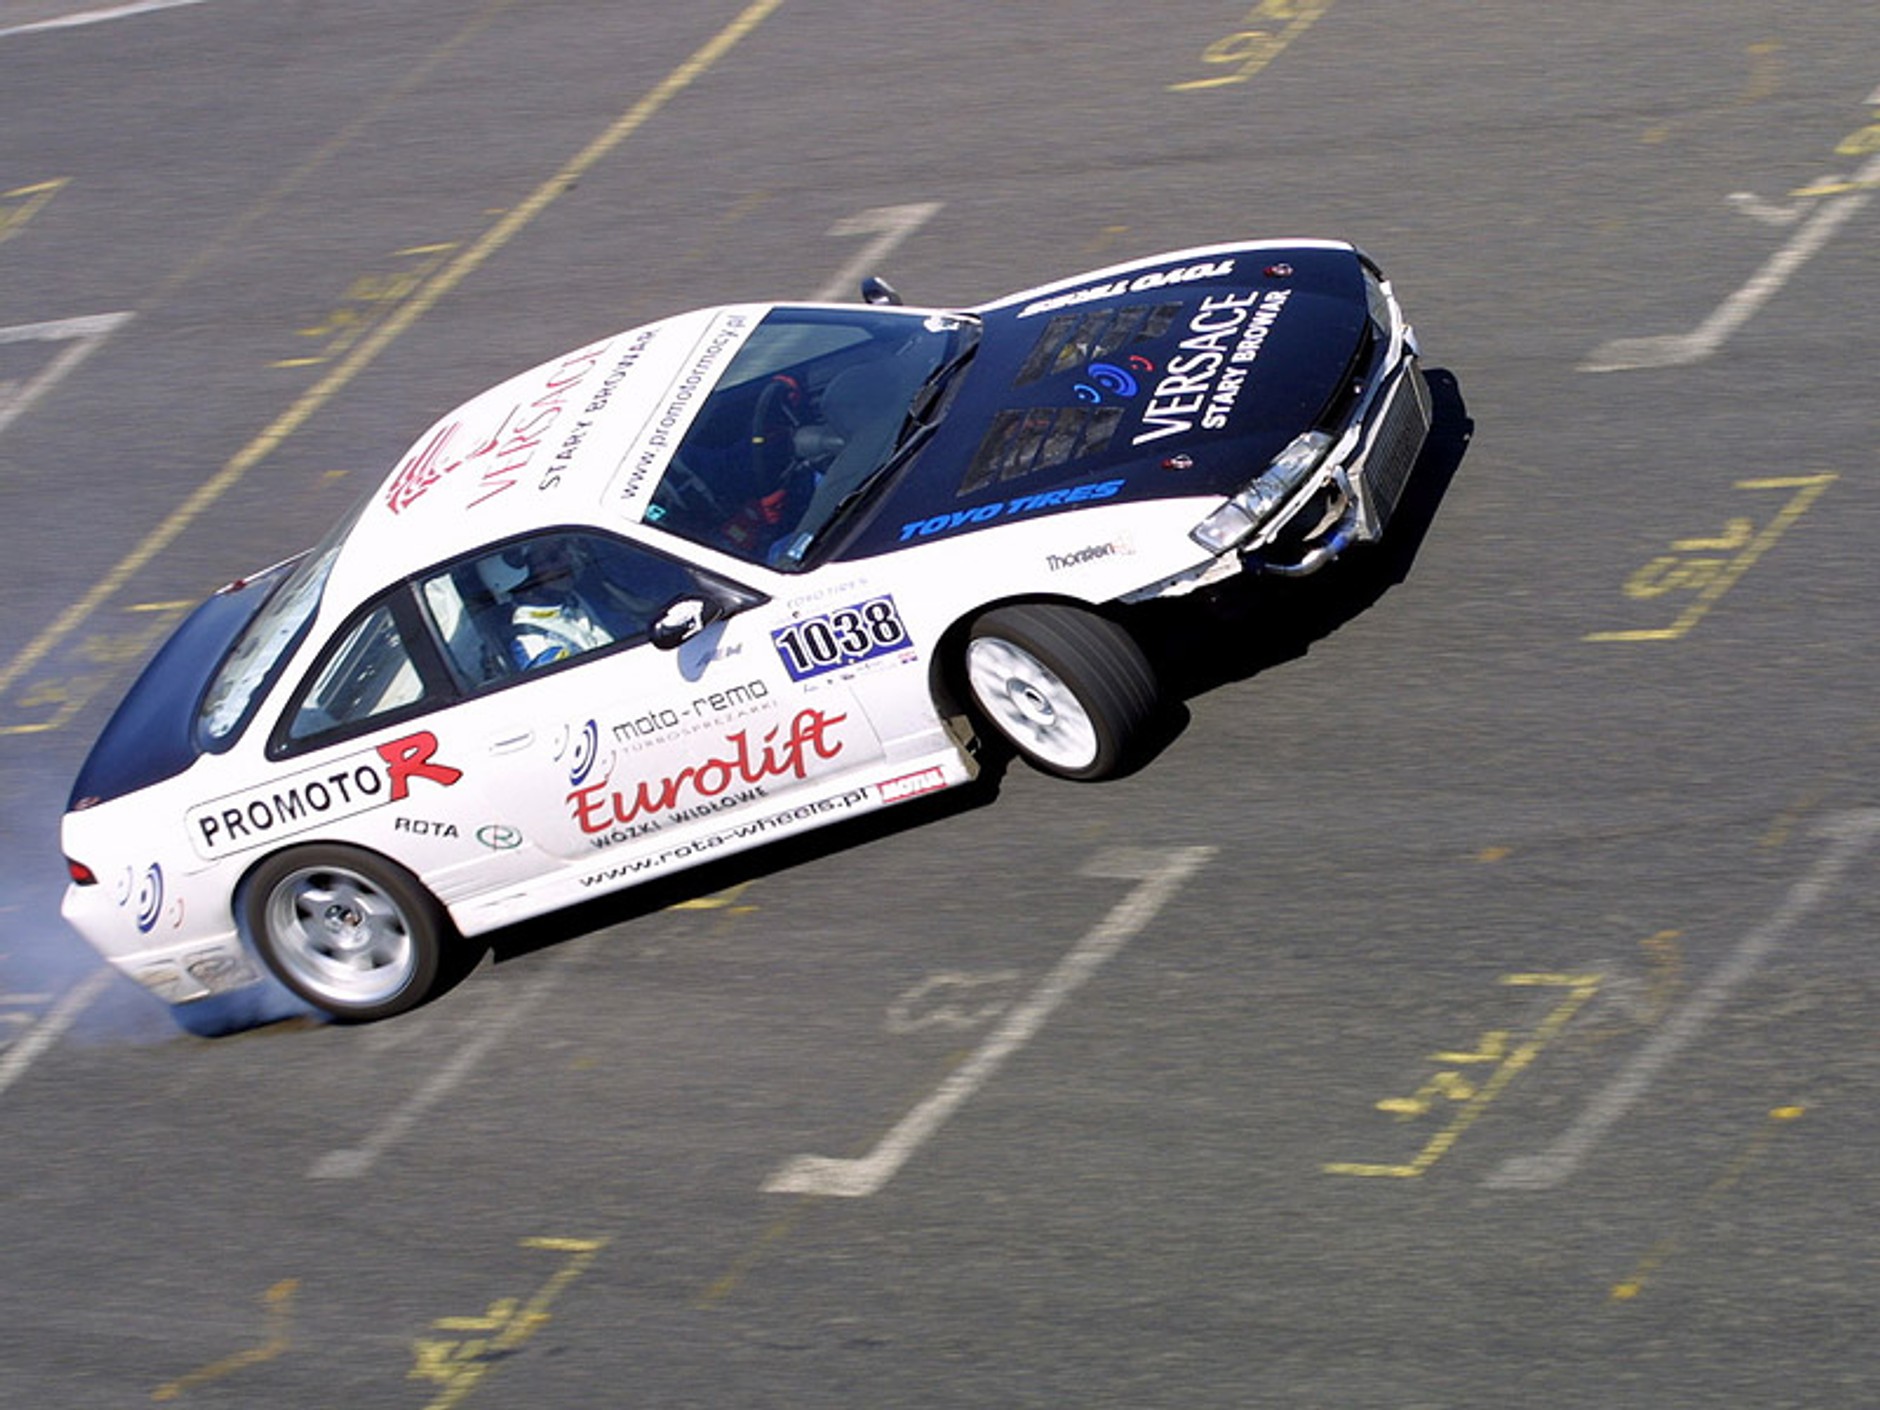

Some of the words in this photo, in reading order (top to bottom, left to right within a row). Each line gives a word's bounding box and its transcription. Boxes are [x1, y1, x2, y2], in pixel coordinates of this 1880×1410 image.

[1132, 290, 1258, 446] VERSACE
[1203, 362, 1251, 430] STARY
[1230, 288, 1292, 365] BROWAR
[900, 503, 1004, 541] TOYO
[1006, 479, 1126, 514] TIRES
[780, 602, 902, 670] 1038
[612, 680, 768, 743] moto-remo
[199, 731, 463, 847] PROMOTOR
[567, 709, 847, 834] Eurolift
[395, 818, 458, 839] ROTA
[580, 788, 868, 886] www.rota-wheels.pl
